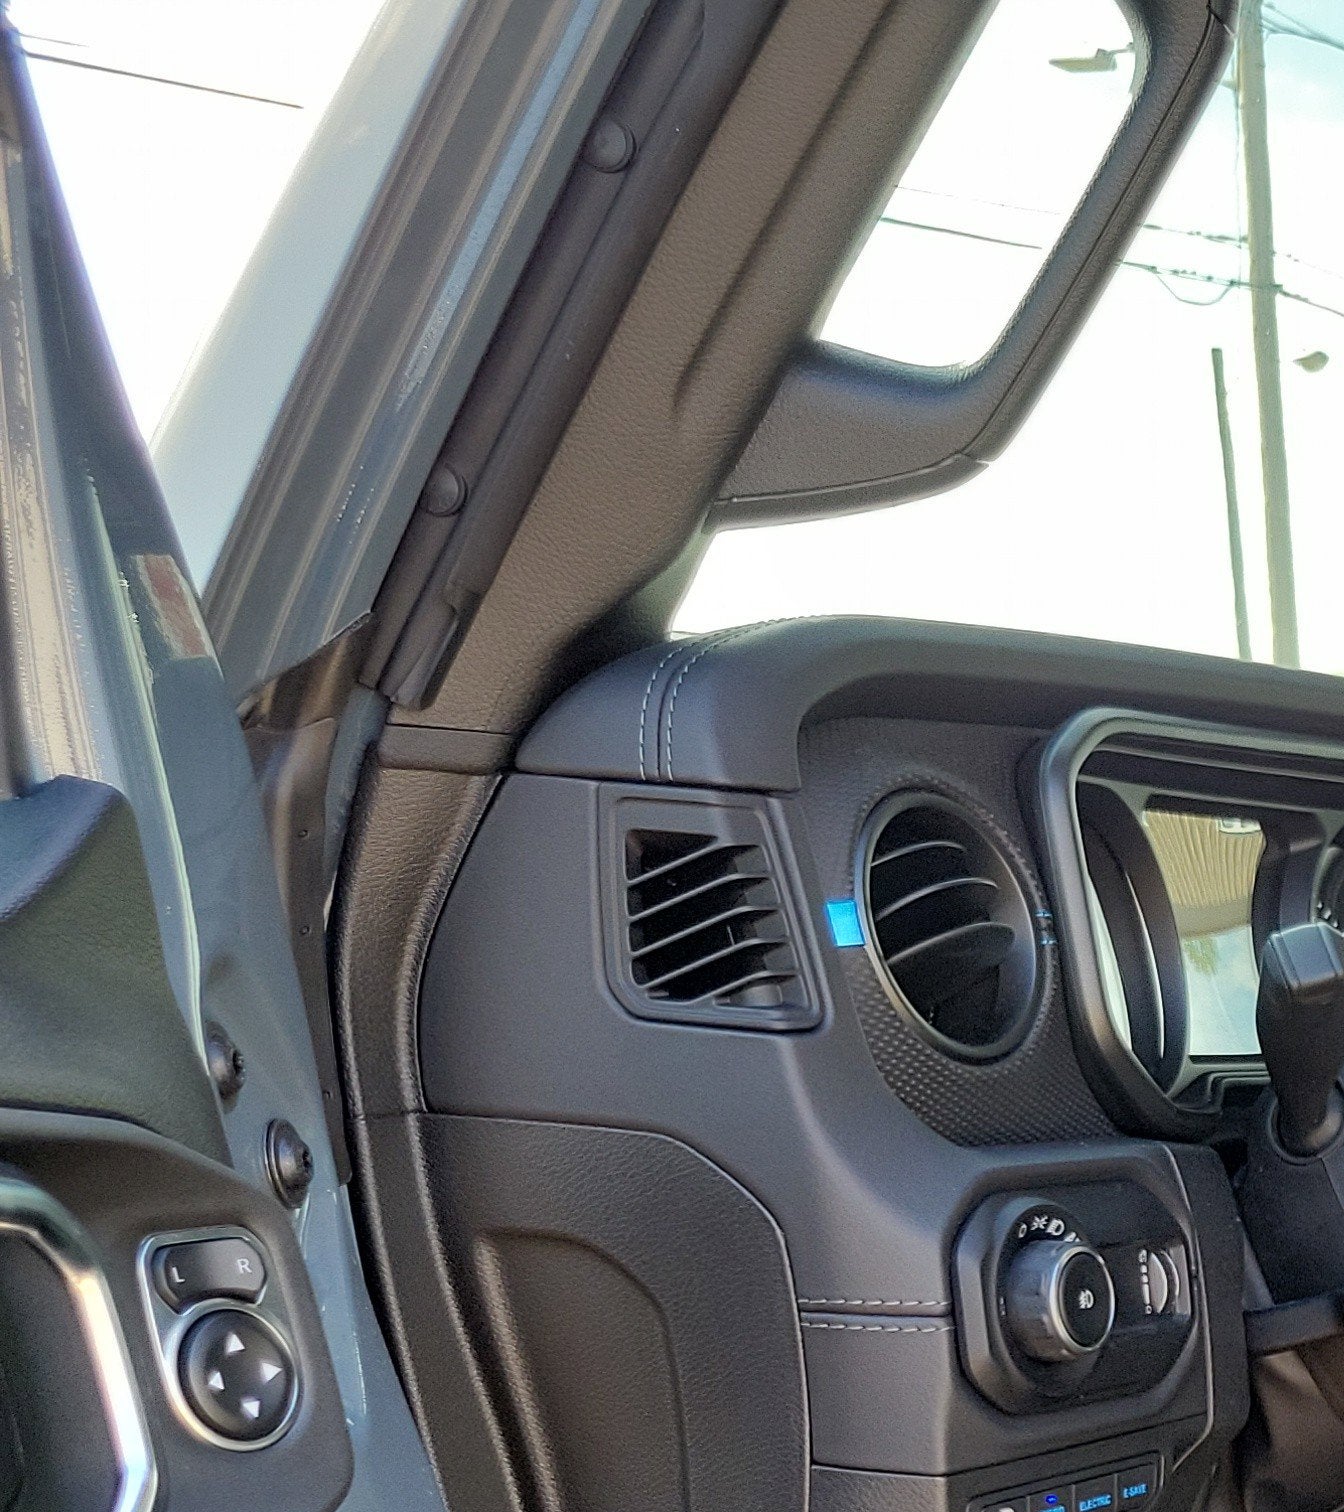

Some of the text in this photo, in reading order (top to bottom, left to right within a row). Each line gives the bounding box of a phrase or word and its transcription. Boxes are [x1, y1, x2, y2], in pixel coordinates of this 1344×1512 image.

[236, 1258, 252, 1274] R
[172, 1267, 185, 1283] L
[1079, 1494, 1112, 1512] ELECTRIC
